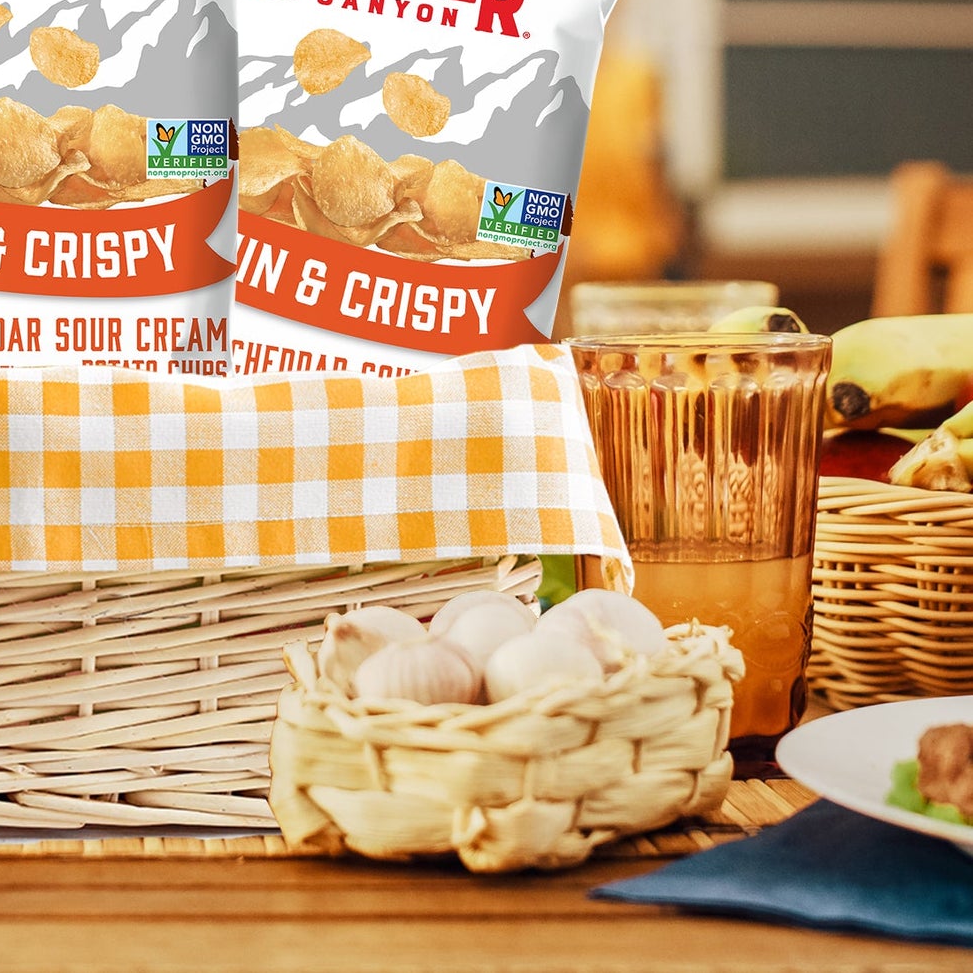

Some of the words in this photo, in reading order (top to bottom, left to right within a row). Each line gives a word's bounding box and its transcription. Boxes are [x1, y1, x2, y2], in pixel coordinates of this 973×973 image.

[191, 123, 224, 134] NON
[190, 134, 225, 145] GMO
[191, 145, 224, 156] Project
[152, 157, 224, 167] VERIFIED
[147, 169, 228, 178] nongmoproject.org
[528, 192, 561, 207] NON
[525, 204, 560, 218] GMO
[524, 214, 557, 227] Project
[485, 219, 556, 240] VERIFIED
[477, 231, 558, 251] nongmoproject.org
[23, 223, 177, 279] CRISPY
[236, 233, 289, 295] IN
[294, 258, 328, 306] &
[339, 270, 497, 335] CRISPY
[55, 317, 122, 352] SOUR
[136, 317, 227, 352] CREAM
